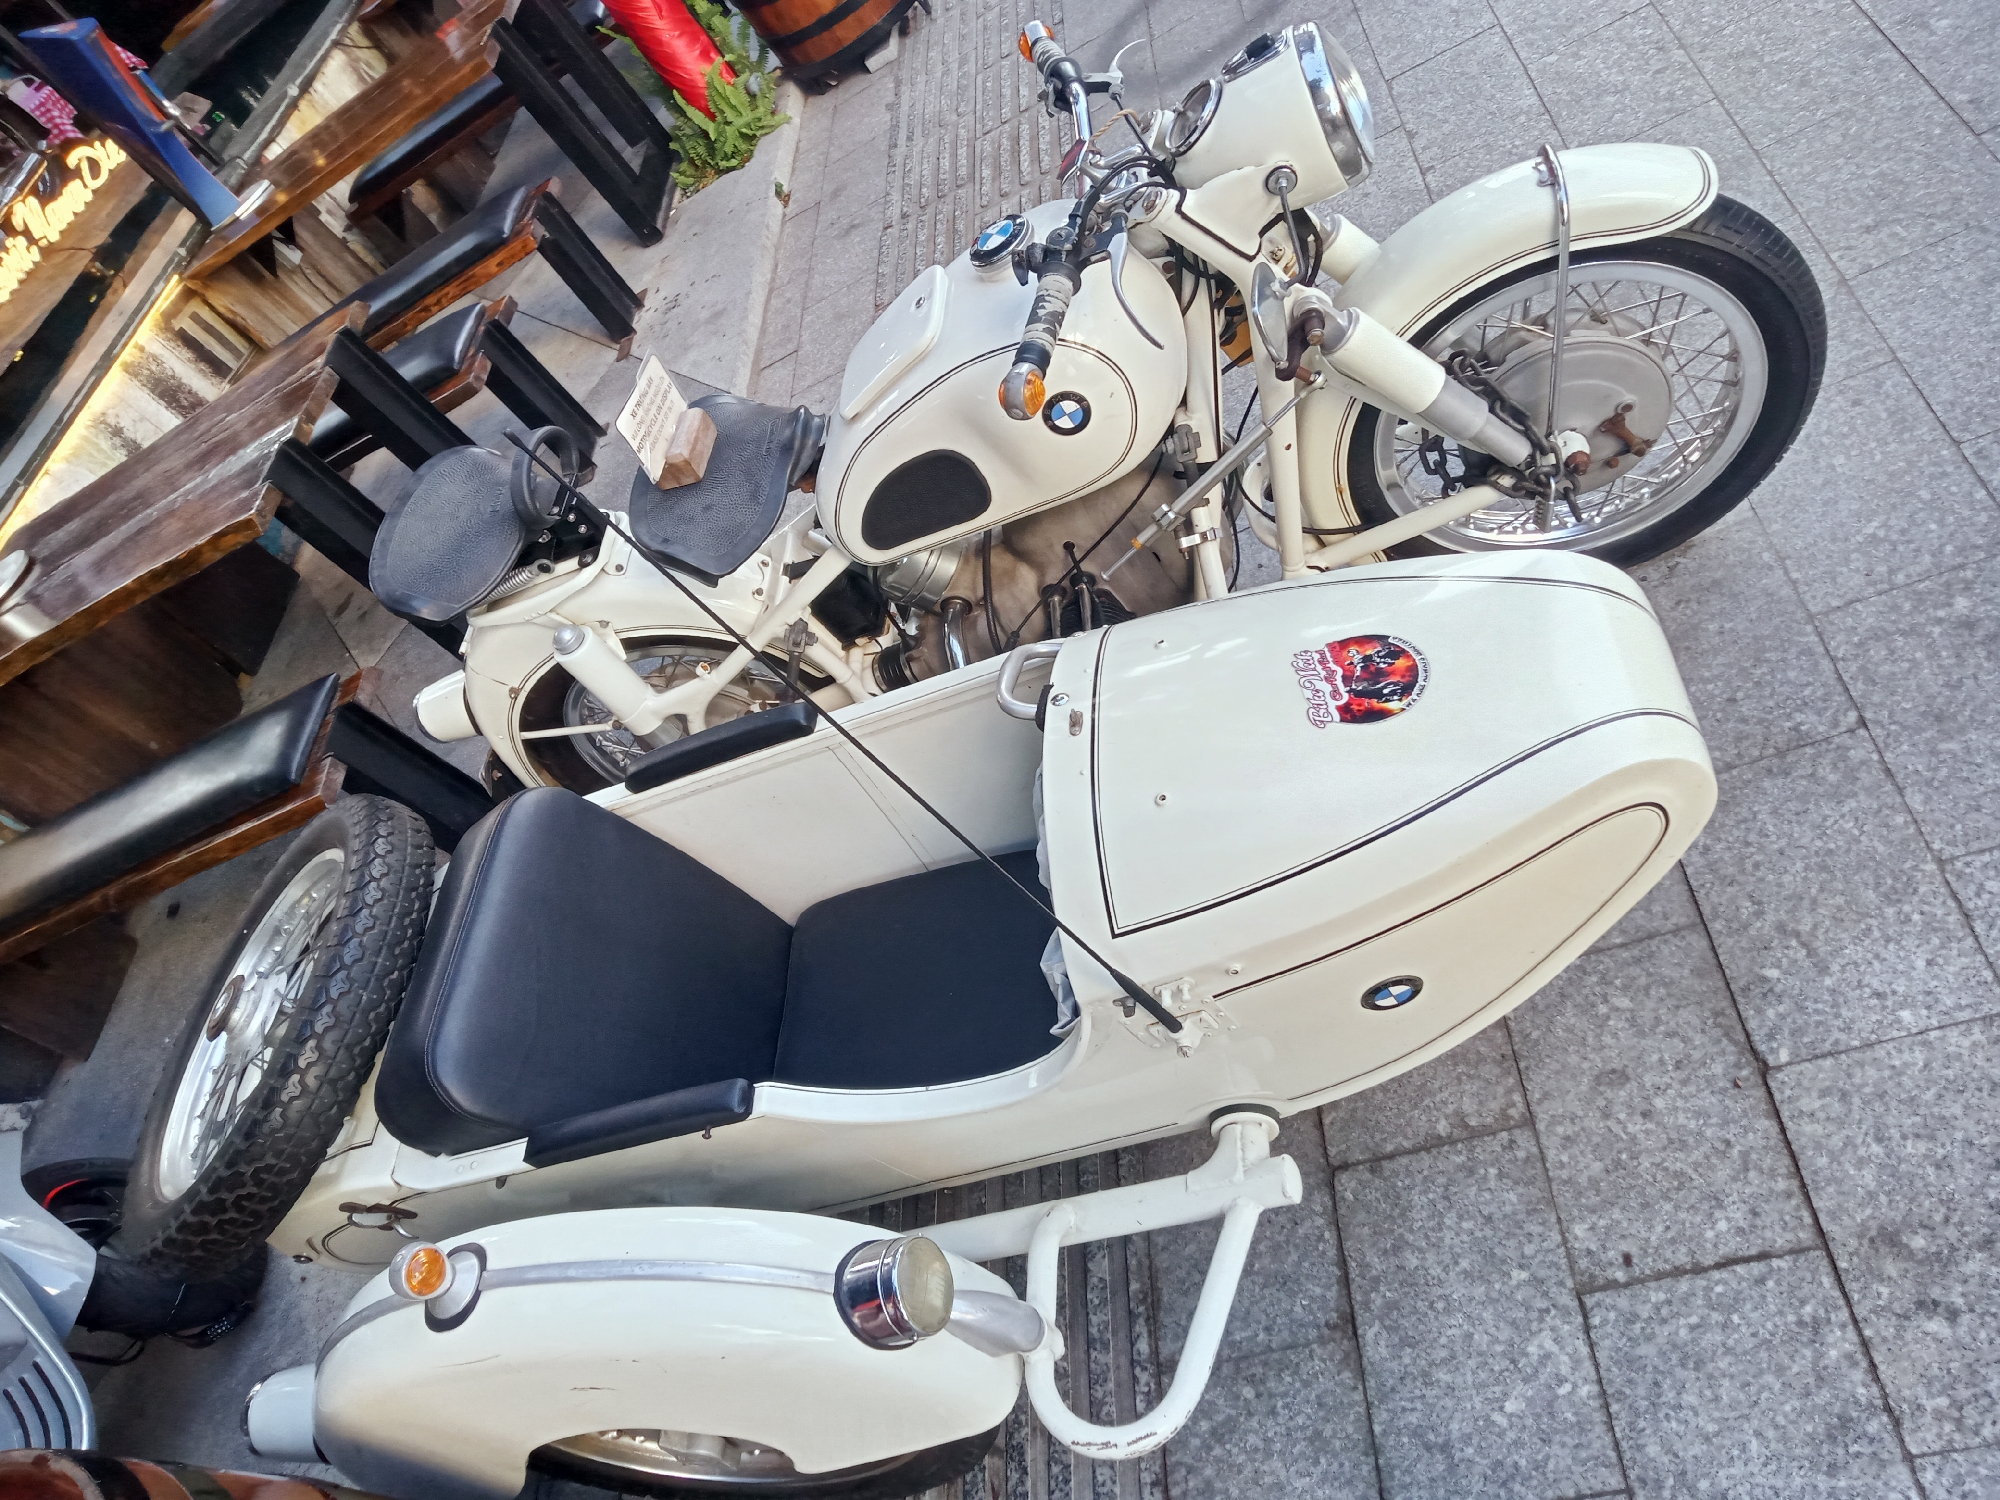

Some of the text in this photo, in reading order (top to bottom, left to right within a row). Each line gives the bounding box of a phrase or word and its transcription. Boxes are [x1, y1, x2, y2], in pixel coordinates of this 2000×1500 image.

[629, 407, 638, 421] XE
[635, 380, 674, 456] MOTORCYCLE ON DISPLAY
[1291, 650, 1323, 690] Week
[1307, 689, 1333, 728] Bike
